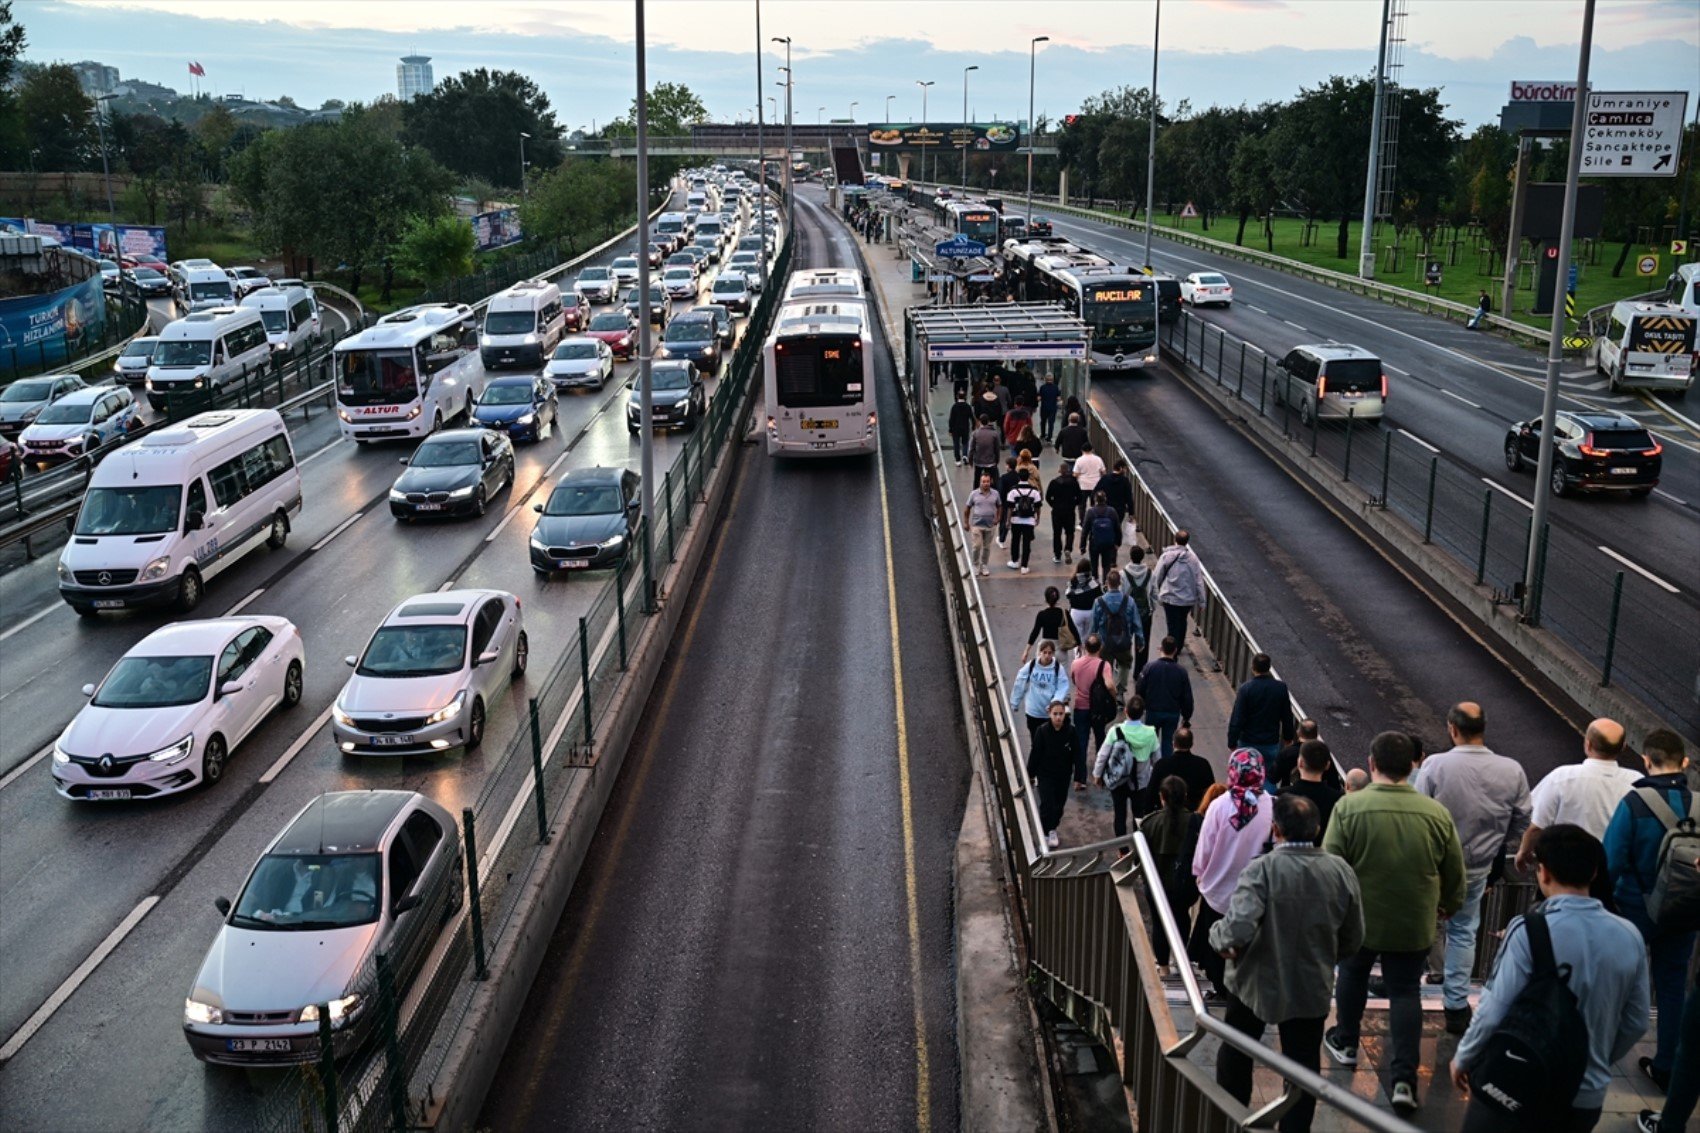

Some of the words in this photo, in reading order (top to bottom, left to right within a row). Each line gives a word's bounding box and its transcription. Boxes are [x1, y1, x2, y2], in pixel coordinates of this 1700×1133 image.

[1591, 97, 1670, 110] Ümraniye
[1590, 113, 1652, 125] Çamlıca
[1587, 128, 1664, 140] Çekmeköy
[1586, 142, 1671, 153] Sancaktepe
[1584, 156, 1613, 167] Şile
[1095, 290, 1142, 302] AVCILAR
[363, 405, 399, 415] ALTUR
[233, 1041, 245, 1049] 23
[252, 1041, 257, 1049] P
[265, 1040, 288, 1050] 2142
[1481, 1082, 1521, 1112] NIKE
